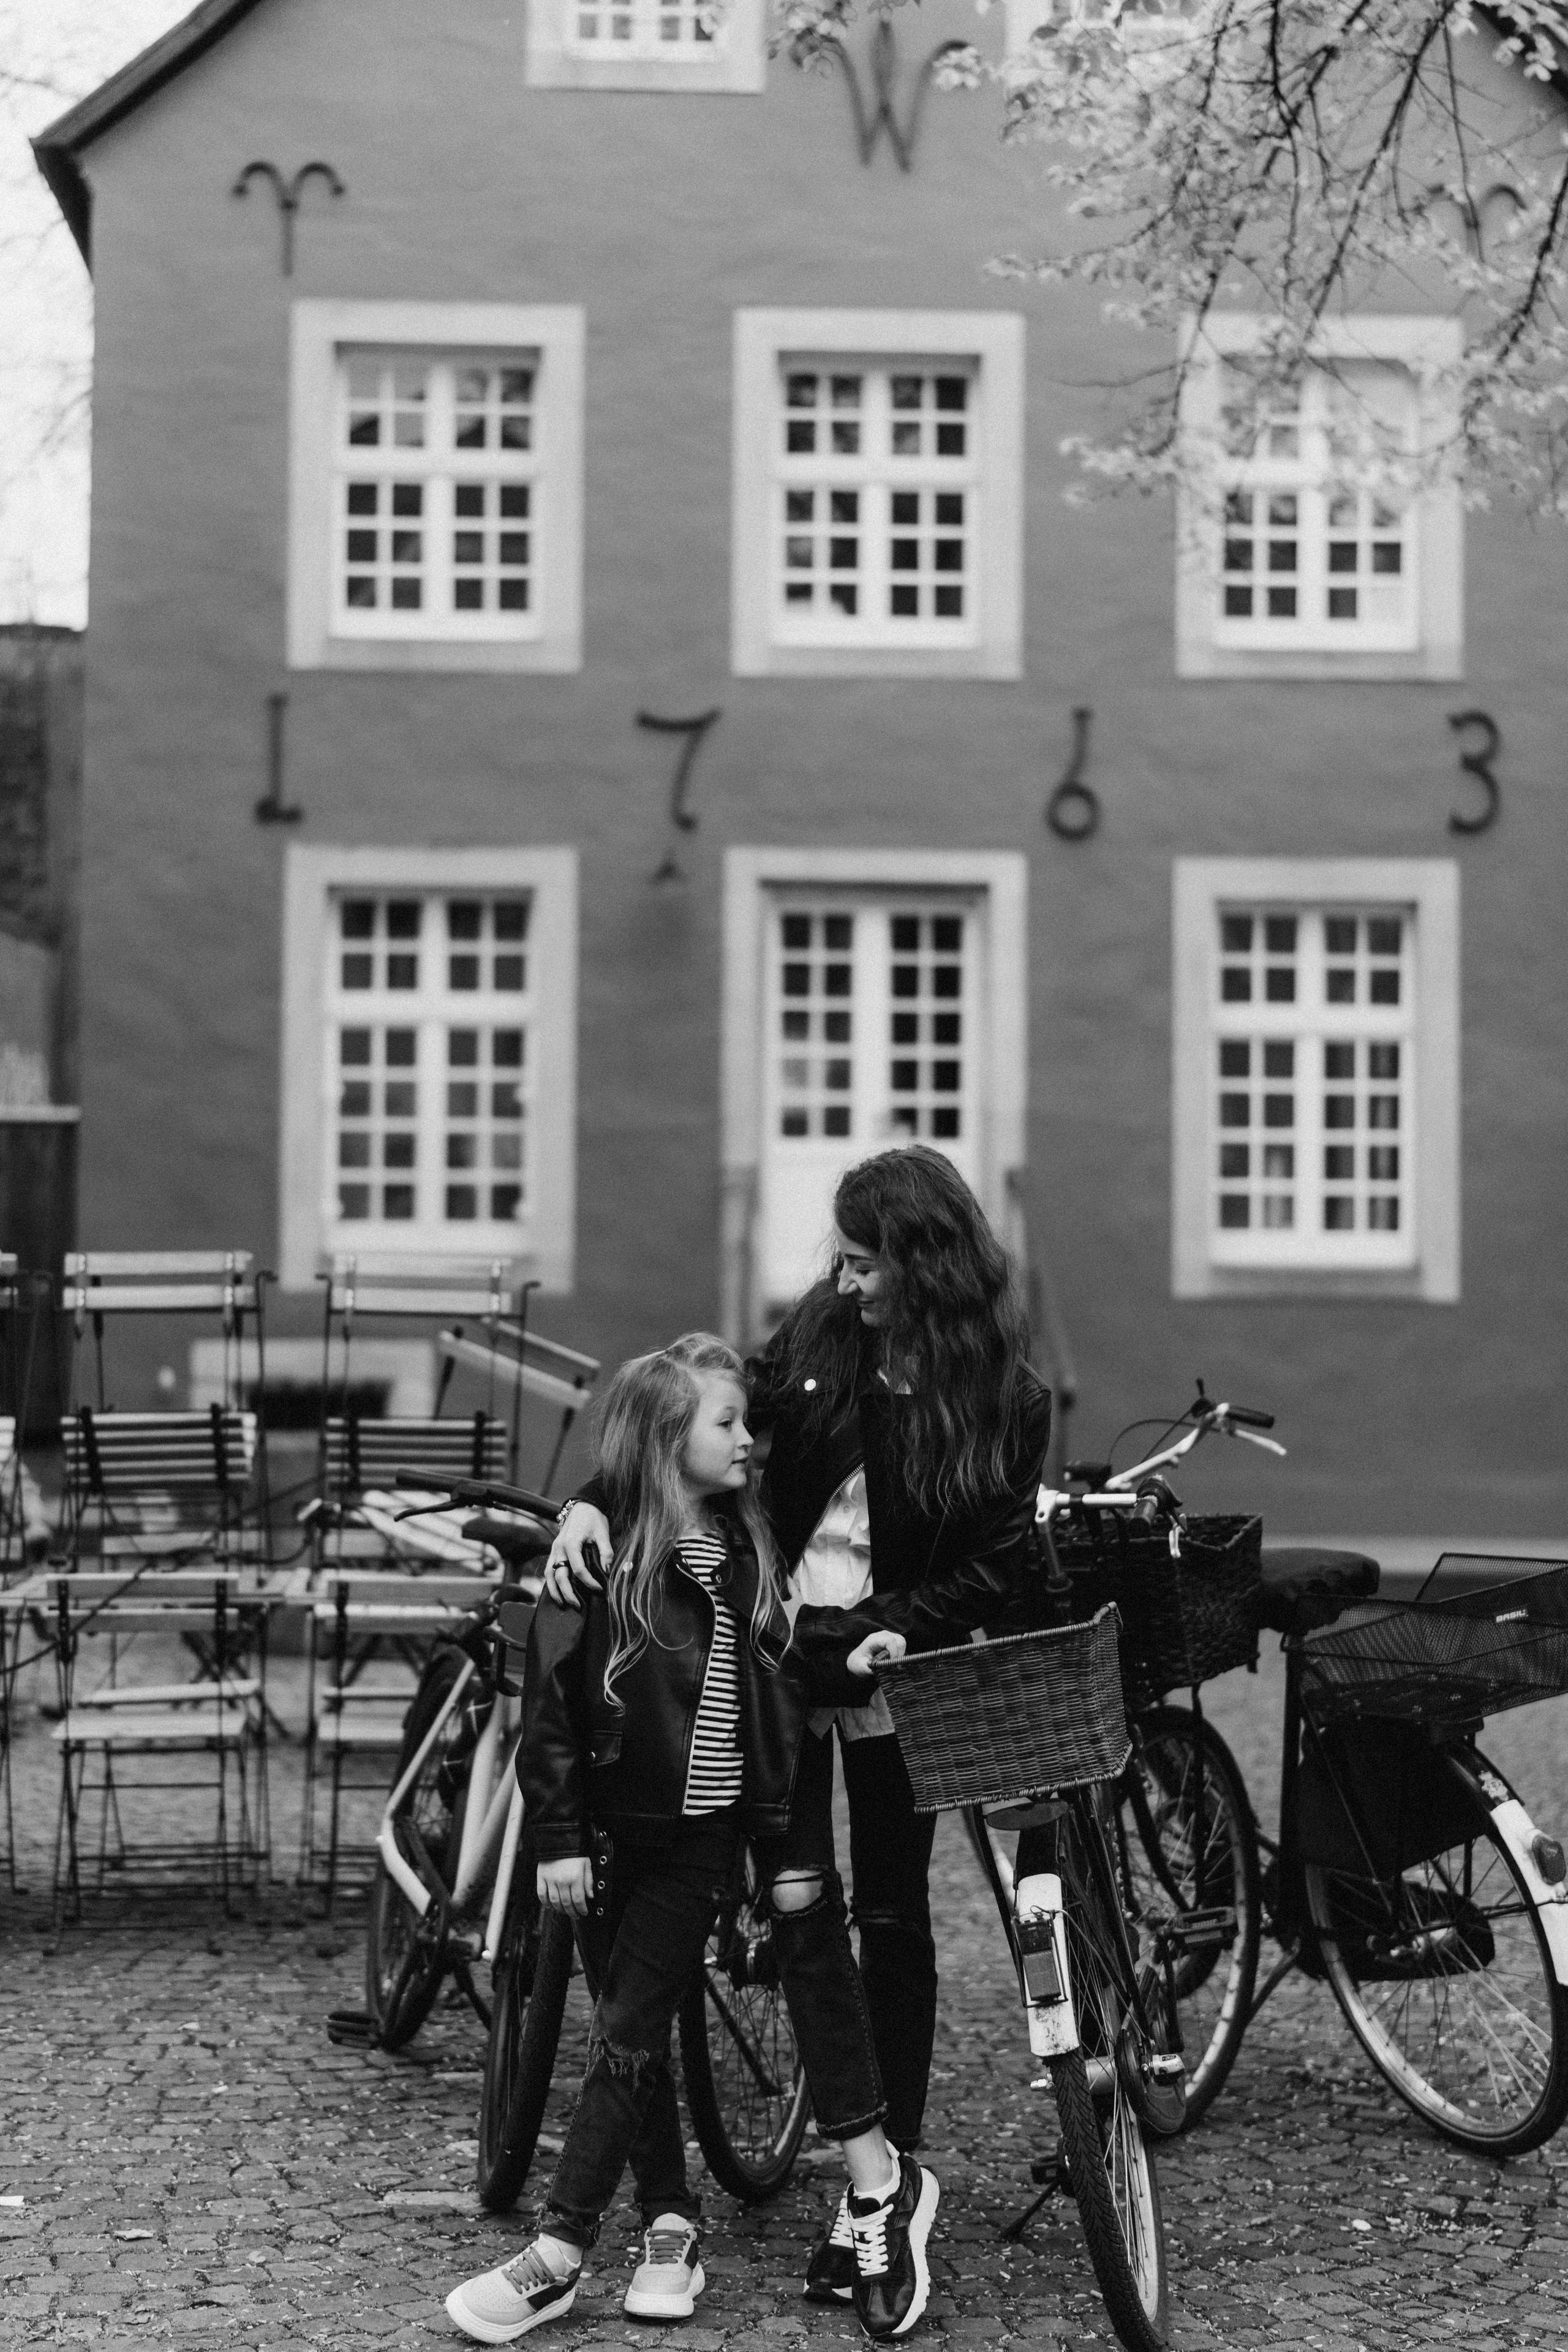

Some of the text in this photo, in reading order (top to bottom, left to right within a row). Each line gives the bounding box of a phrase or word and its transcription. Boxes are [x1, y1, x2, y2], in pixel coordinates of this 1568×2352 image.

[254, 693, 1502, 843] 1 7 6 3
[1496, 1609, 1526, 1623] BASIL
